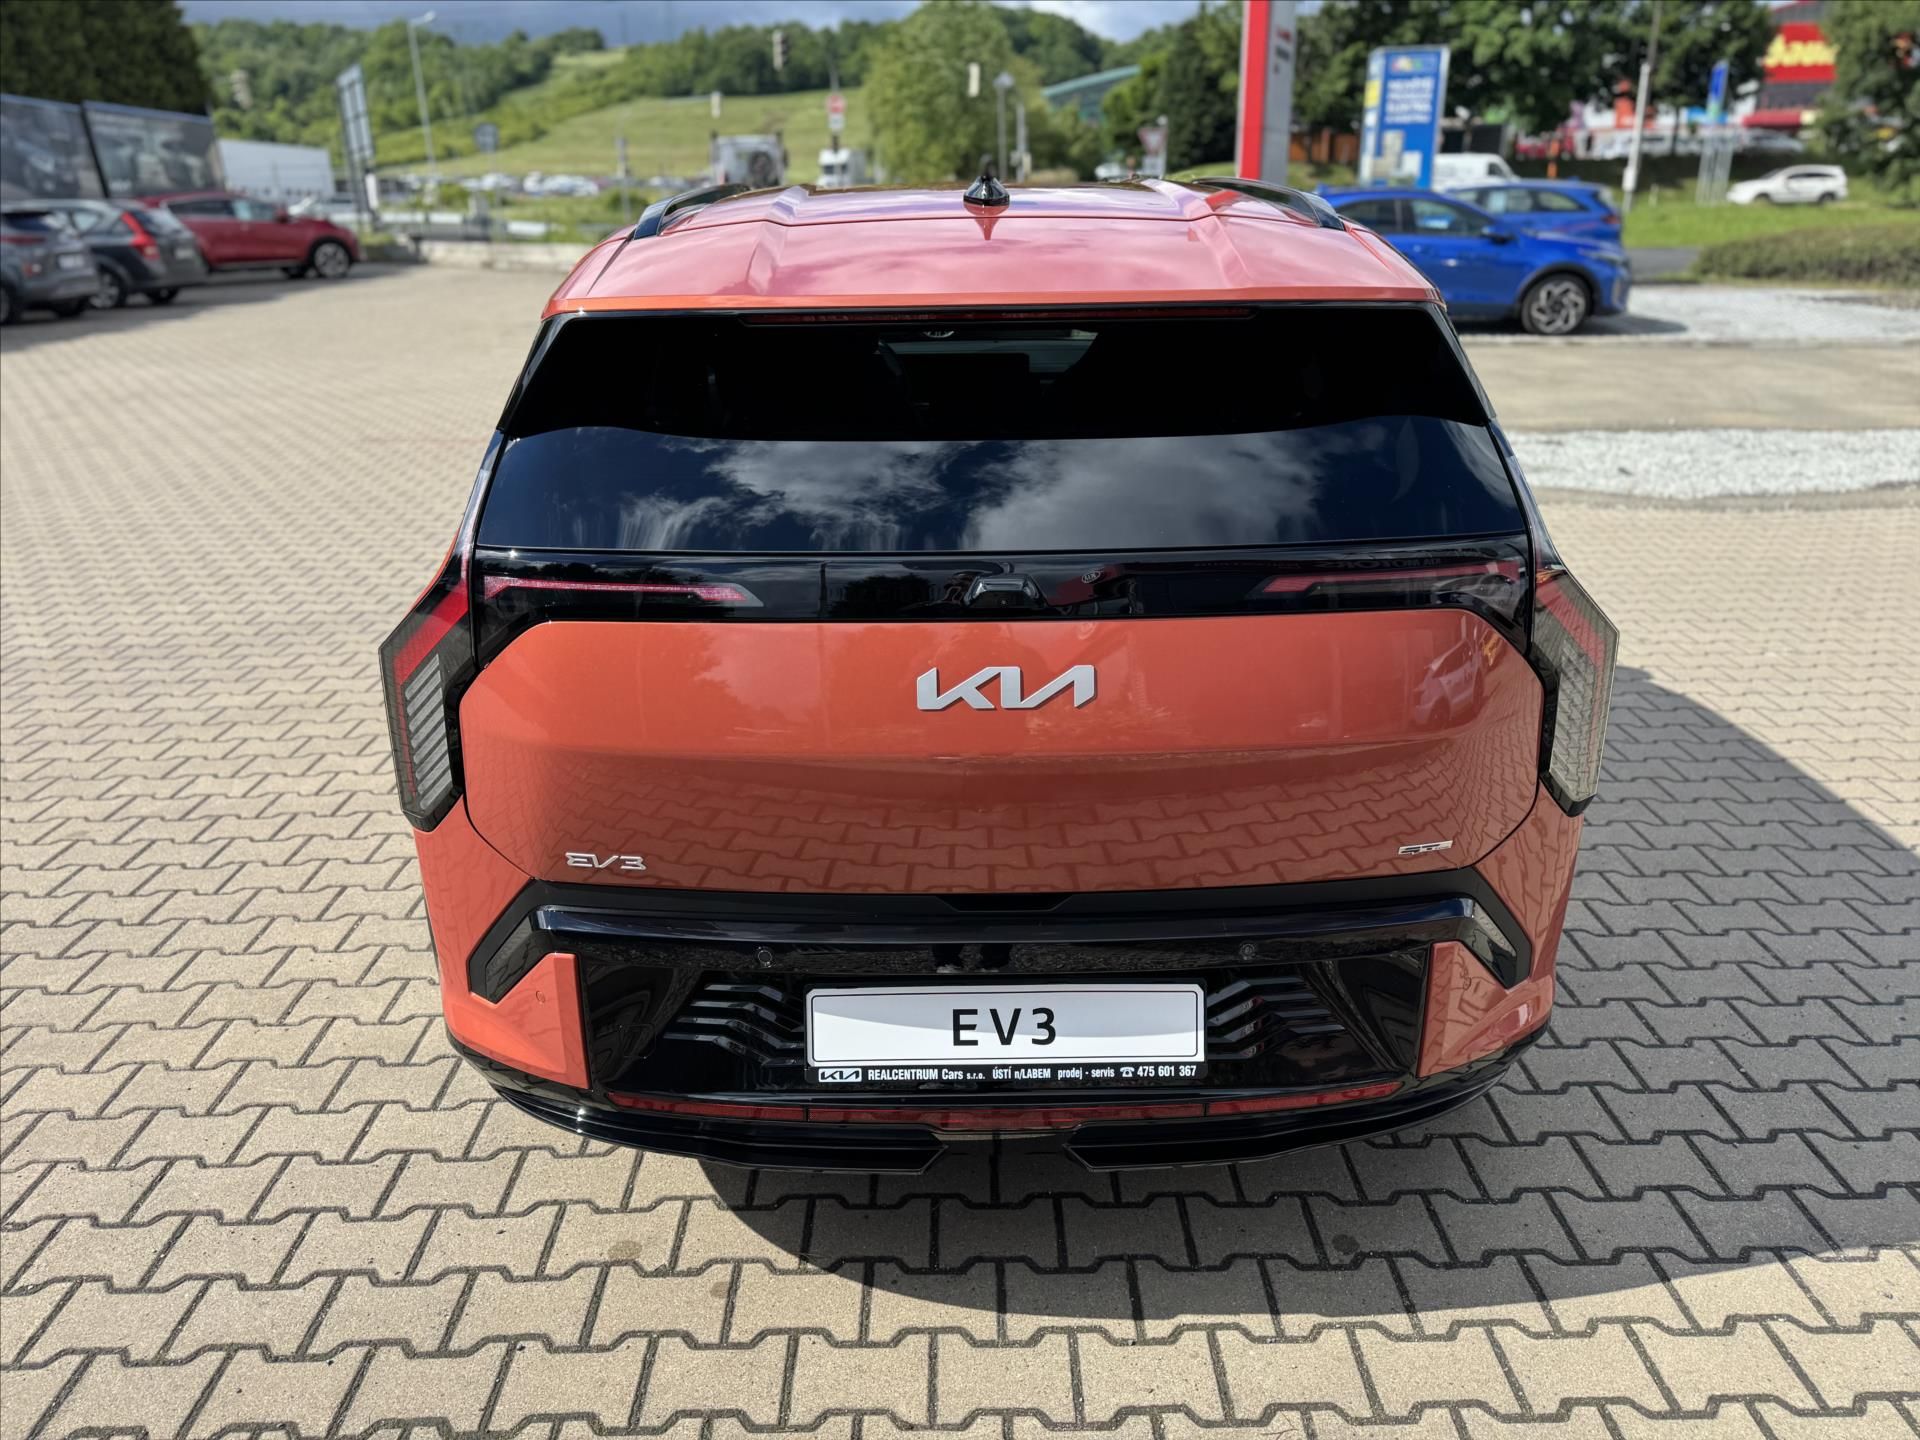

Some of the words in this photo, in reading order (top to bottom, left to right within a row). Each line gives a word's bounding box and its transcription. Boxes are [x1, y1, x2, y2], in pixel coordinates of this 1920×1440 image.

[916, 664, 1095, 710] KIA
[565, 851, 647, 871] EV3
[952, 1007, 1057, 1047] EV3
[820, 1070, 860, 1081] KIA
[867, 1068, 938, 1081] REALCENTRUM
[941, 1068, 964, 1080] Cars
[992, 1065, 1012, 1080] ÚSTÍ
[1014, 1068, 1051, 1080] n/LABEM
[1057, 1067, 1083, 1081] prodej
[1090, 1066, 1116, 1078] servis
[1136, 1065, 1156, 1077] 475
[1157, 1065, 1175, 1077] 601
[1178, 1065, 1197, 1077] 367
